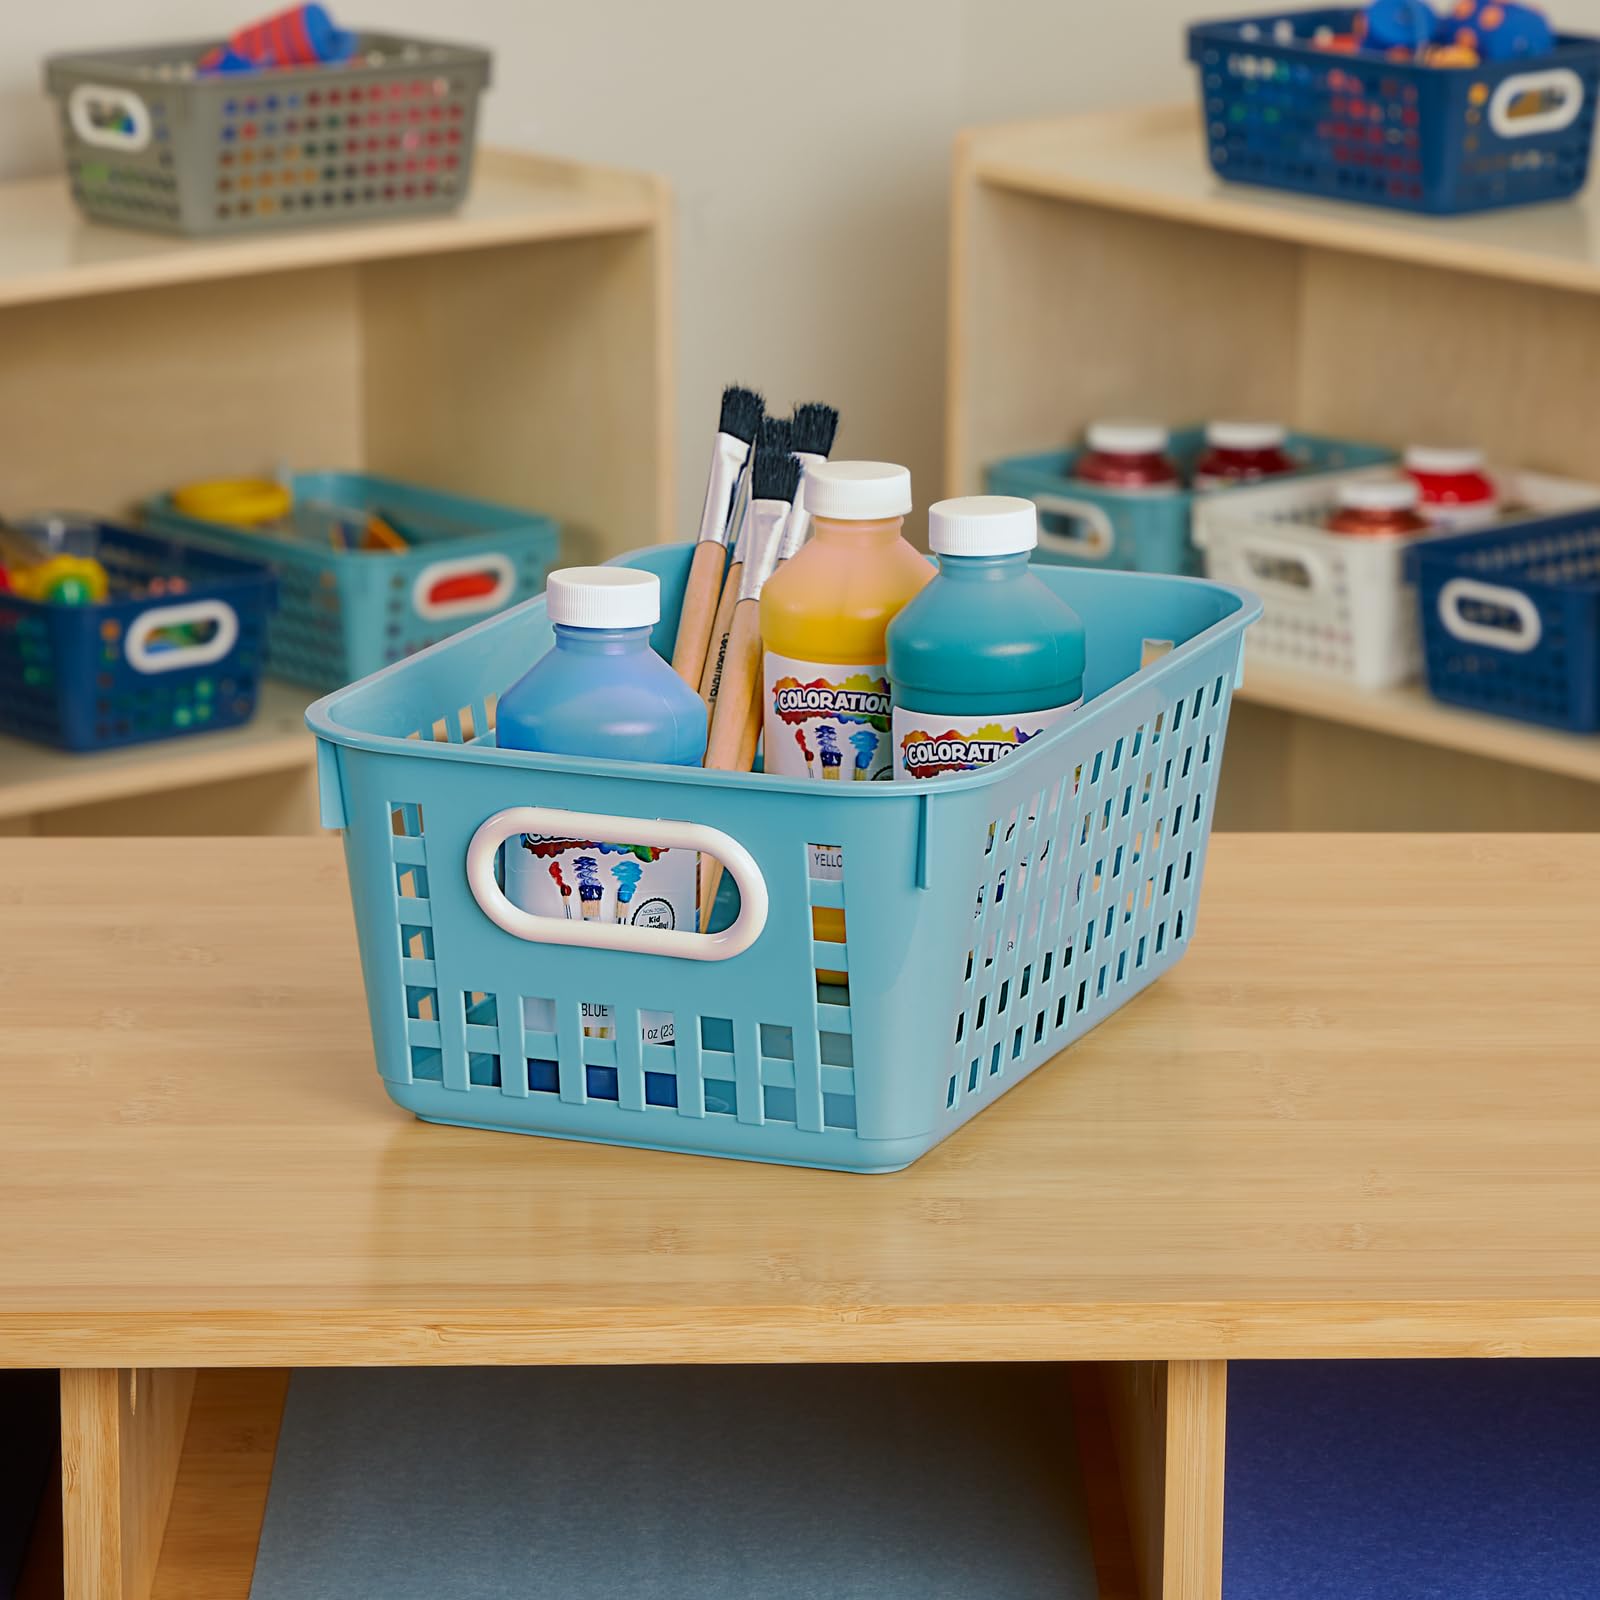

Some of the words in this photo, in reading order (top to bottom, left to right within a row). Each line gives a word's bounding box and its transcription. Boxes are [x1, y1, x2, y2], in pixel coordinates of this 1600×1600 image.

[907, 741, 1021, 764] COLORATIO
[648, 915, 661, 924] Kid
[581, 1003, 608, 1017] BLUE
[647, 1029, 658, 1040] oz
[660, 1023, 674, 1040] (23
